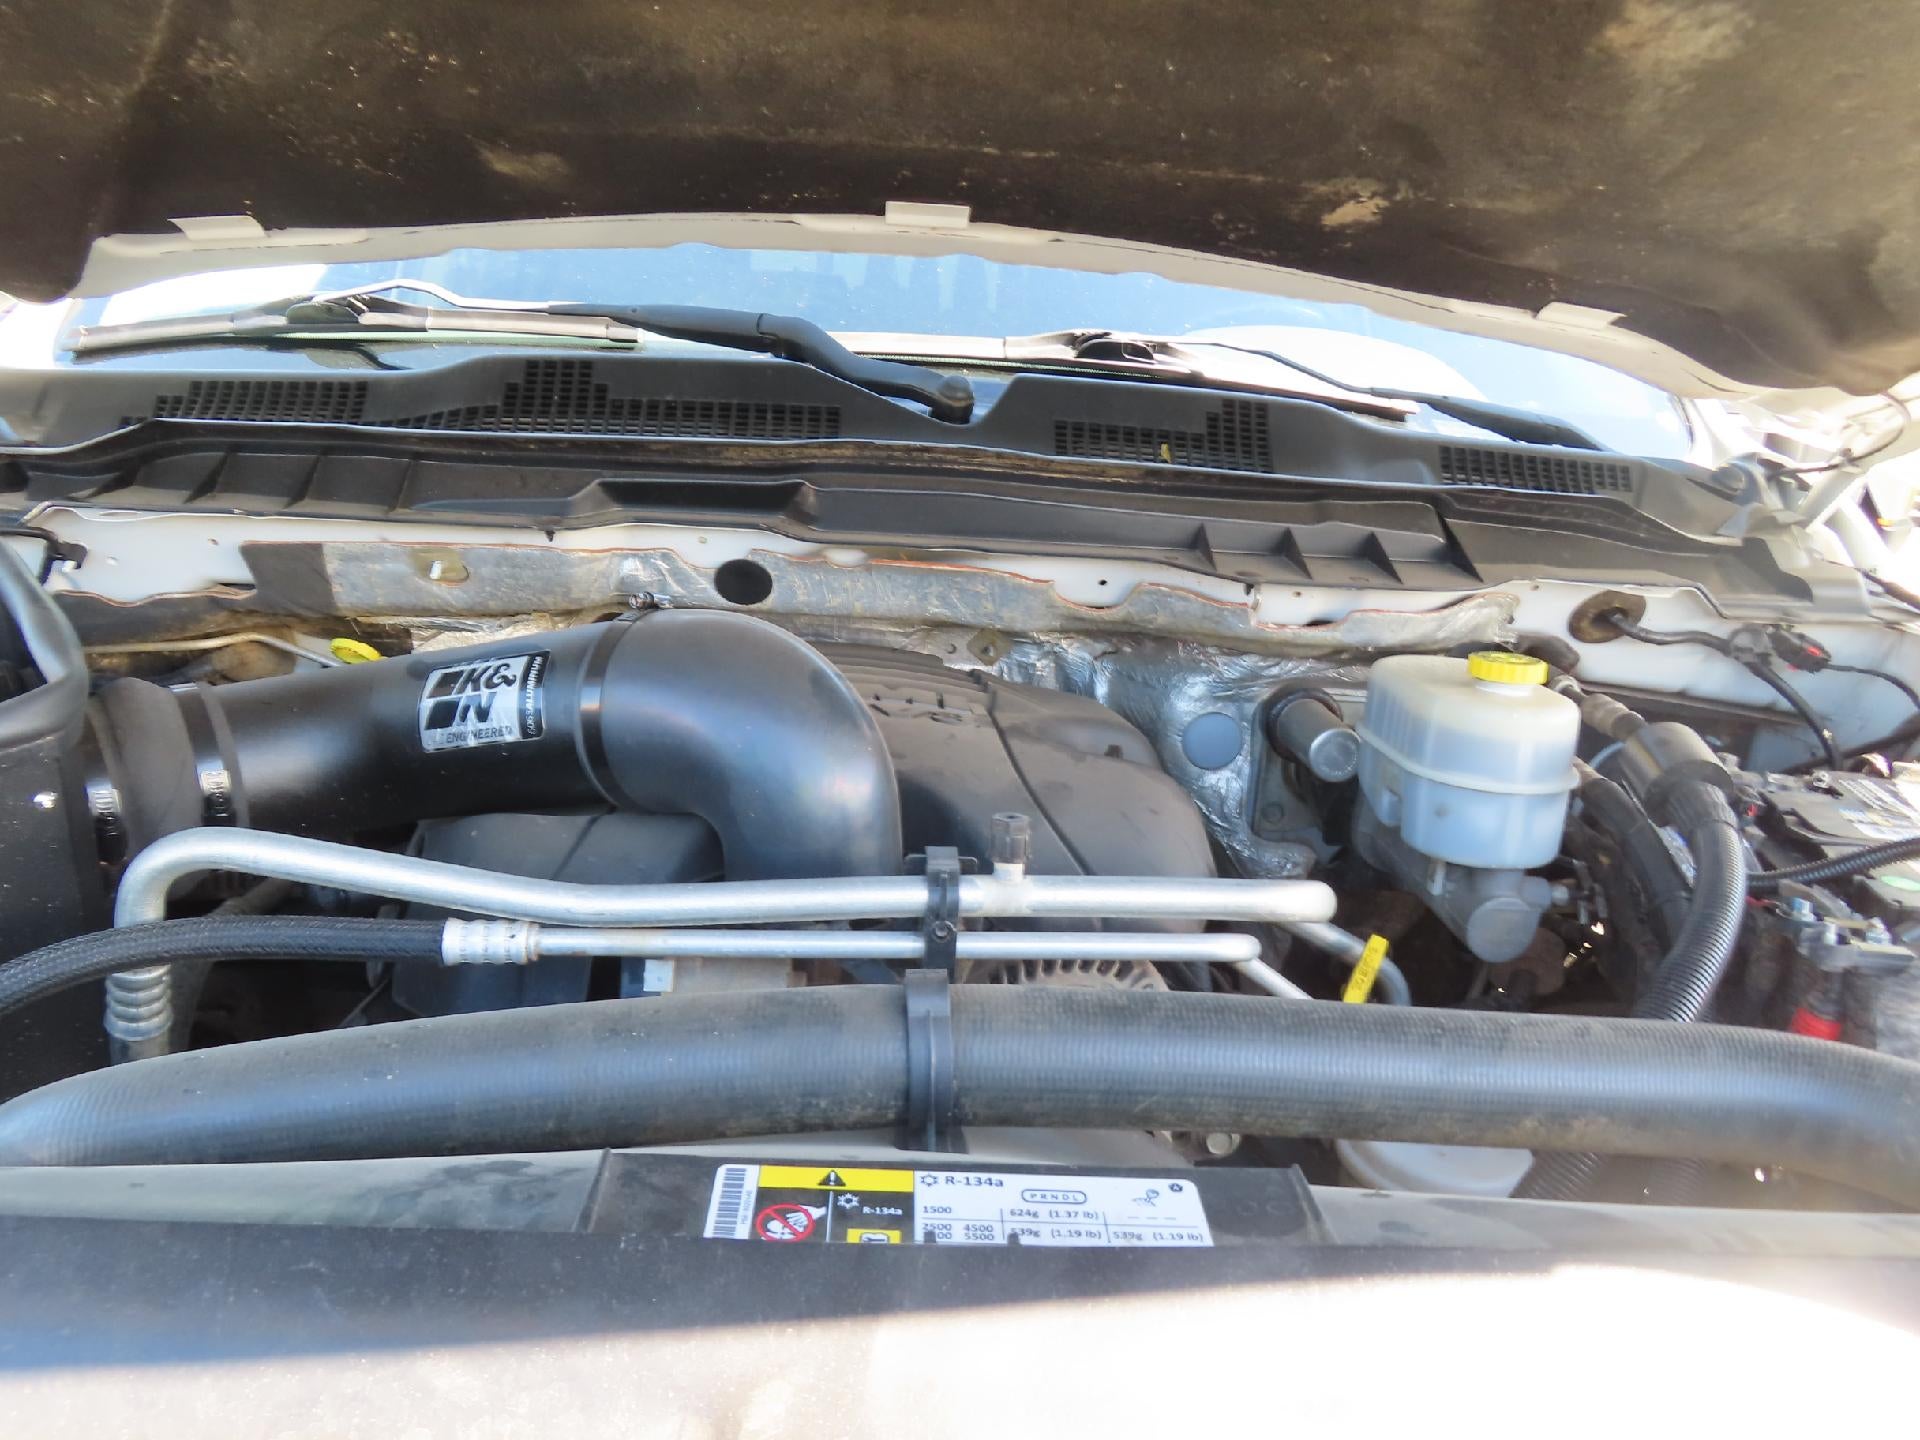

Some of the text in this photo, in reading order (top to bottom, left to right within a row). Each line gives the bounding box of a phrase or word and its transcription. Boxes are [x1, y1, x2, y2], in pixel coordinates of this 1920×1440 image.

[945, 1176, 1004, 1187] R-134a
[863, 1205, 903, 1216] R-134a
[922, 1206, 952, 1214] 1500
[1009, 1209, 1039, 1218] 624g
[922, 1223, 994, 1232] 2500 4500
[1051, 1228, 1081, 1239] (1.19
[1085, 1229, 1101, 1239] lb)
[1112, 1231, 1204, 1242] 539g (1.19 lb)
